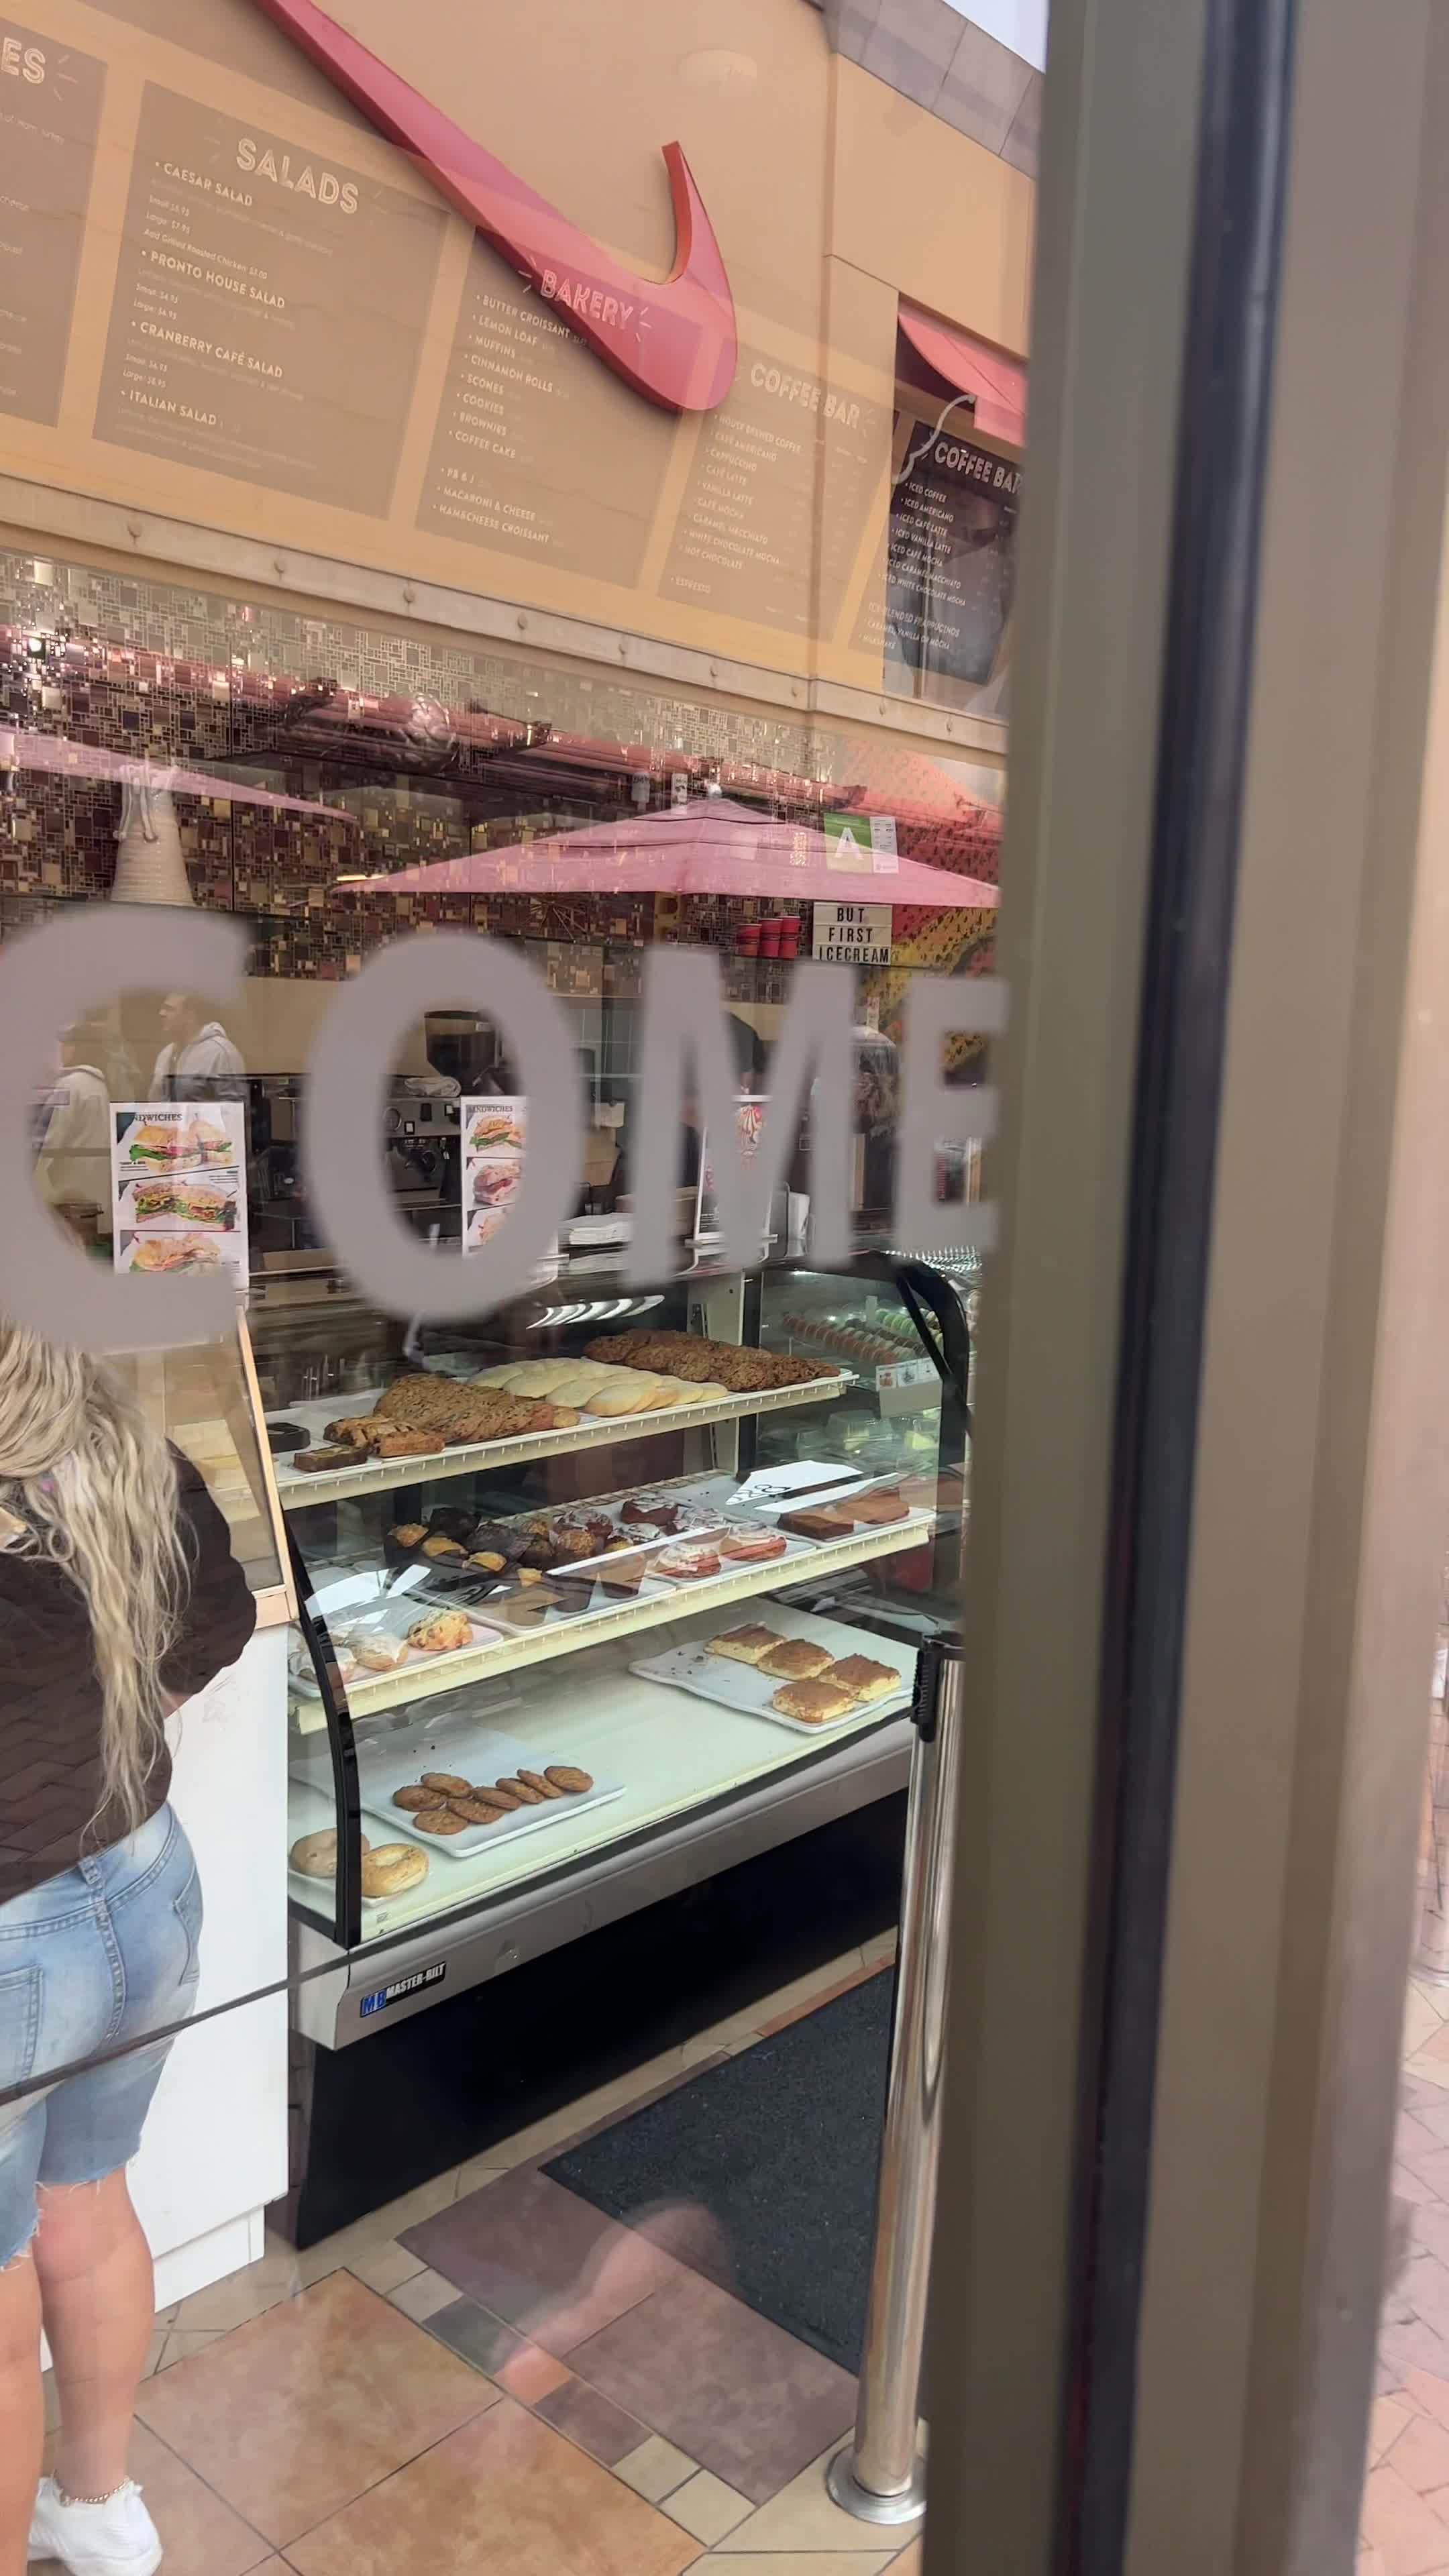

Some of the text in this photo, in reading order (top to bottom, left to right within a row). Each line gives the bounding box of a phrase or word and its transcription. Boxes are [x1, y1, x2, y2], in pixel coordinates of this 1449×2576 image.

[164, 162, 213, 192] CAESAR
[215, 182, 253, 207] SALAD
[236, 138, 360, 215] SALADS
[150, 250, 202, 279] PRONTO
[205, 270, 248, 295] HOUSE
[249, 286, 286, 309] SALAD
[541, 269, 635, 330] BAKERY
[478, 313, 538, 347] LEMON LOAF
[482, 294, 570, 338] BUTTER CROISSANT
[140, 321, 213, 355] CRANBERRY
[246, 357, 284, 380] SALAD
[474, 335, 516, 360] MUFFINS
[466, 373, 505, 396] SCONES
[471, 354, 524, 383] CINNAMON
[525, 373, 553, 393] ROLLS
[129, 389, 217, 426] ITALIAN SALAD
[462, 392, 505, 417] COOKIES
[750, 362, 861, 430] COFFEE BAR
[459, 410, 508, 437] BROWNIES
[454, 429, 517, 460] COFFEE CAKE
[934, 441, 994, 483] COFFEE
[443, 484, 494, 508] MACARONI
[502, 504, 537, 522] CHEESE
[909, 482, 947, 504] ICED COFFEE
[899, 513, 914, 525] ICED
[930, 524, 949, 537] LATTE
[904, 498, 955, 523] ICED AMERICANO
[502, 521, 551, 545] CROISSANT
[895, 528, 953, 555] ICED VANILLA LATTE
[890, 542, 906, 554] ICED
[922, 554, 944, 568] MOCHA
[901, 562, 930, 578] CARAMEL
[929, 572, 962, 590] MACCHIATO
[896, 577, 916, 591] WHITE
[916, 585, 947, 602] CHOCOLATE
[947, 594, 967, 606] MOCHA
[898, 627, 921, 642] VANILLA
[930, 637, 951, 651] MOCHA
[834, 826, 864, 860] A
[837, 906, 865, 923] BUT
[828, 926, 873, 943] FIRST
[819, 945, 890, 965] ICECREAM
[386, 1962, 447, 1999] MASTER-BILT
